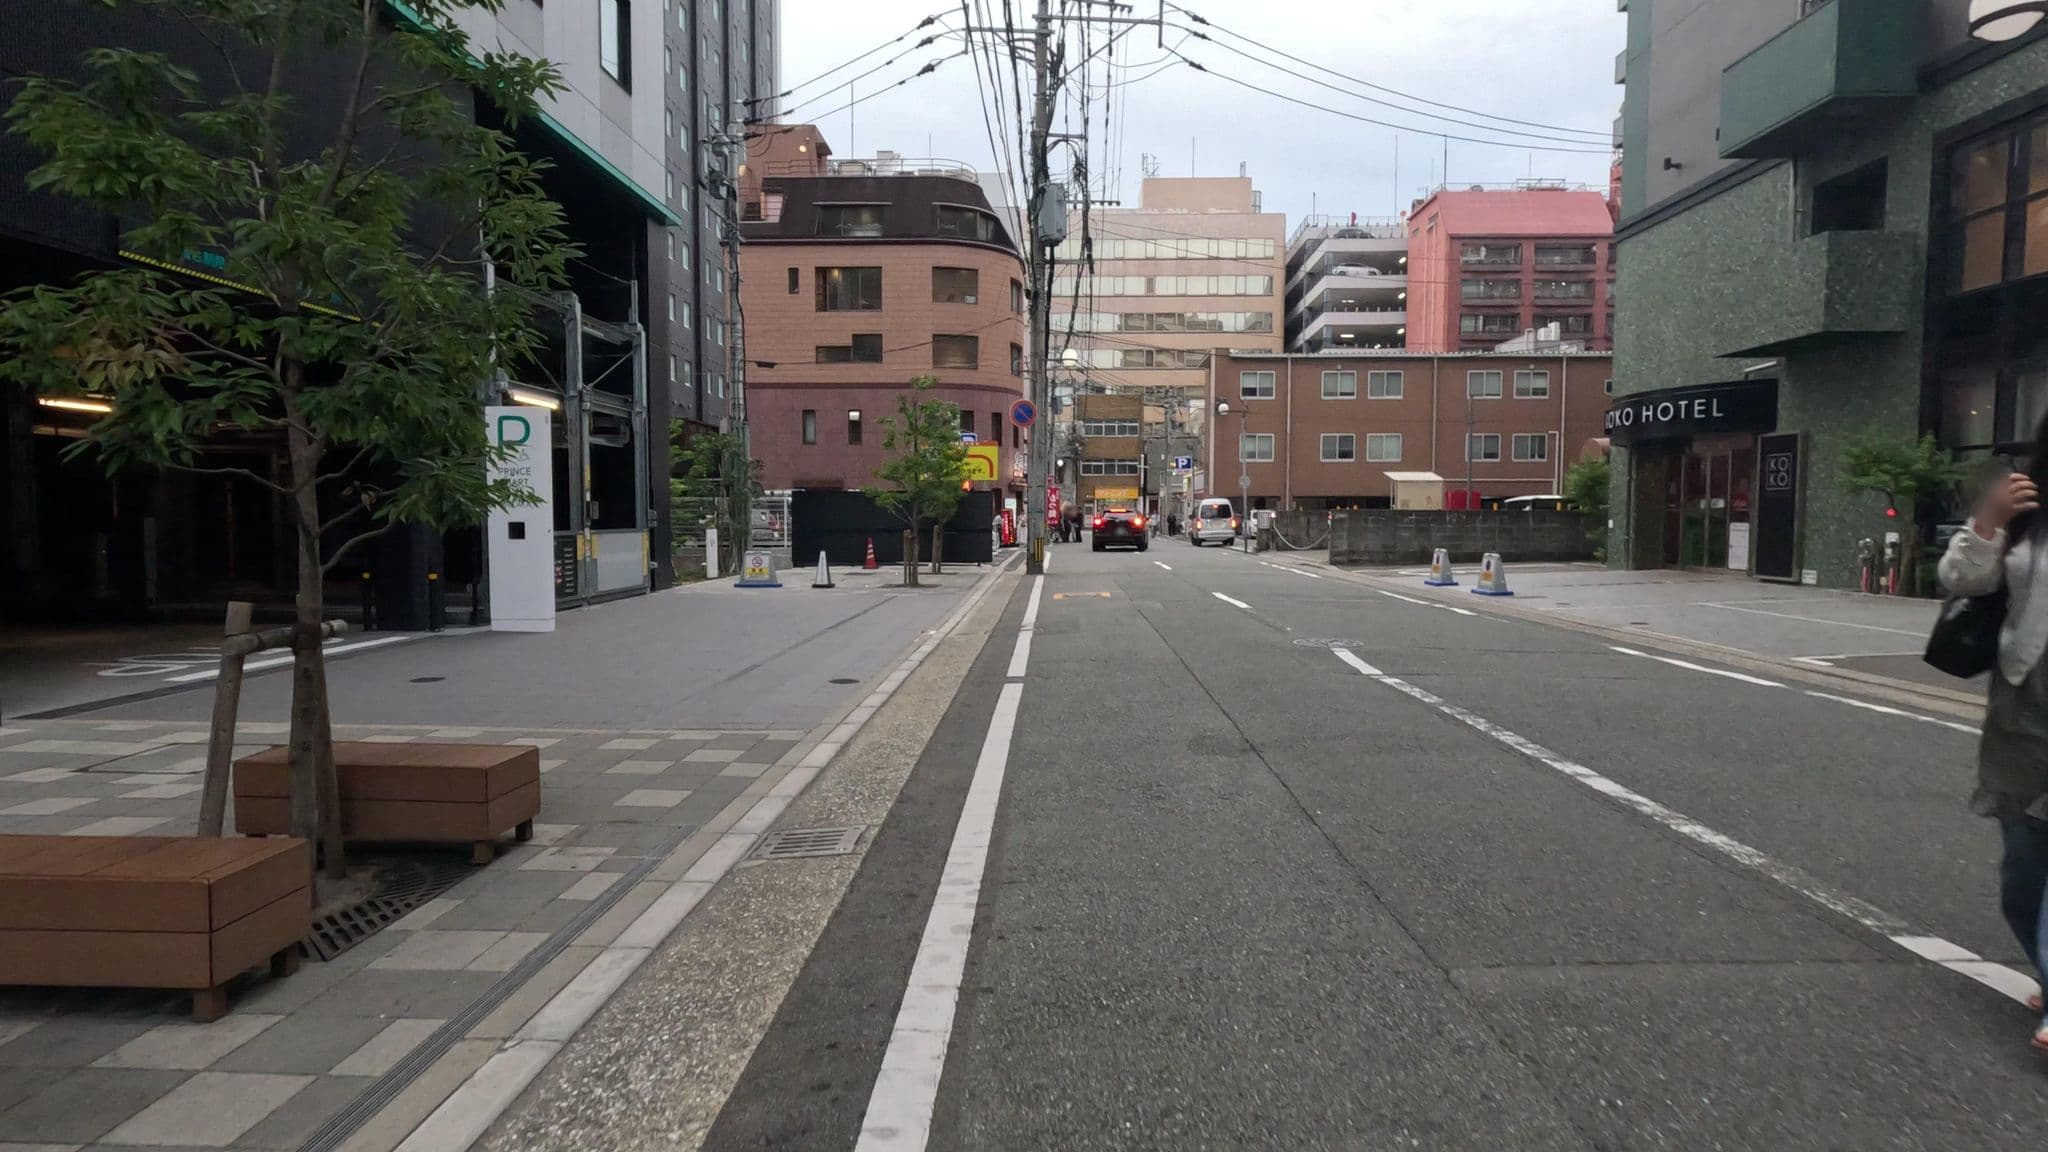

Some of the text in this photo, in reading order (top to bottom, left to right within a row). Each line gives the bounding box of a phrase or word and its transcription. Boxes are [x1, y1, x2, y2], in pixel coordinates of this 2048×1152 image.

[1641, 398, 1724, 423] HOTEL
[497, 415, 532, 460] P
[498, 466, 532, 477] PRINCE
[1178, 458, 1188, 468] P
